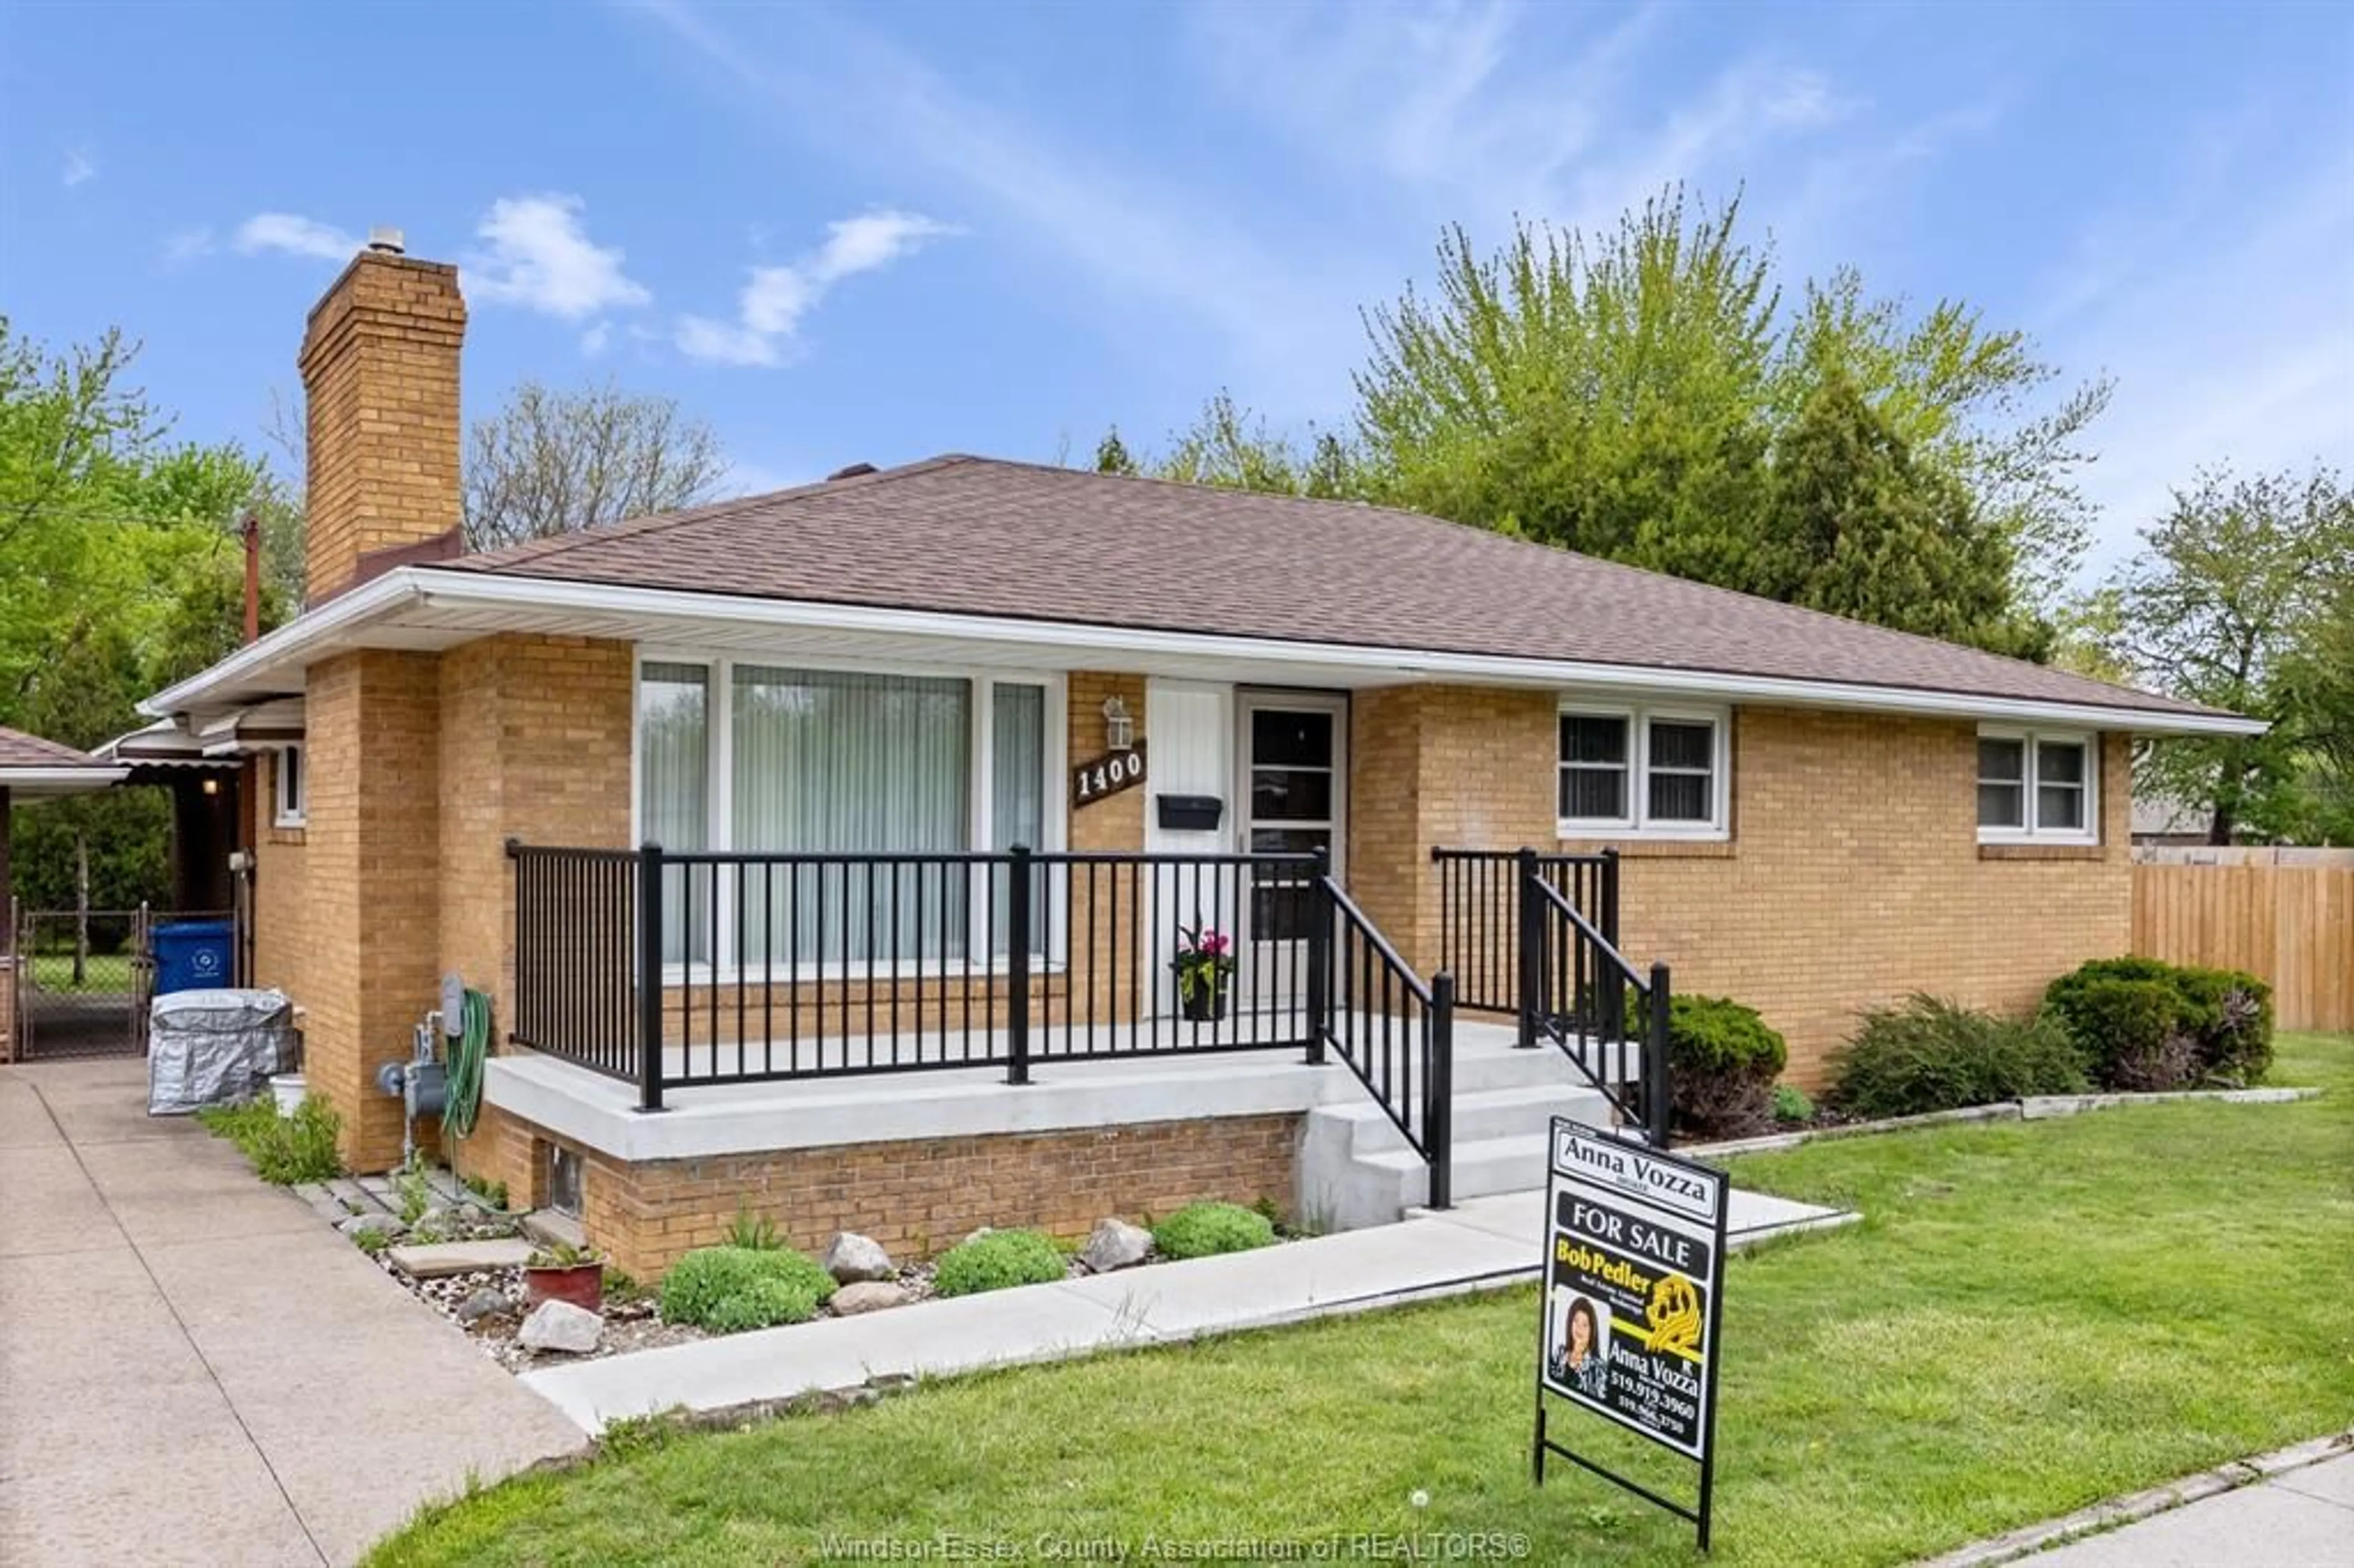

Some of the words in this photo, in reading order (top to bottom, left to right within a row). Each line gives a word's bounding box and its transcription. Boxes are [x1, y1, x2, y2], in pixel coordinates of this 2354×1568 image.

[1079, 753, 1141, 795] 1400
[1564, 1138, 1624, 1174] Anna
[1634, 1159, 1707, 1202] Vozza
[1573, 1203, 1622, 1242] FOR
[1629, 1225, 1691, 1268] SALE
[1609, 1341, 1648, 1375] Anna
[1652, 1357, 1697, 1398] Vozza
